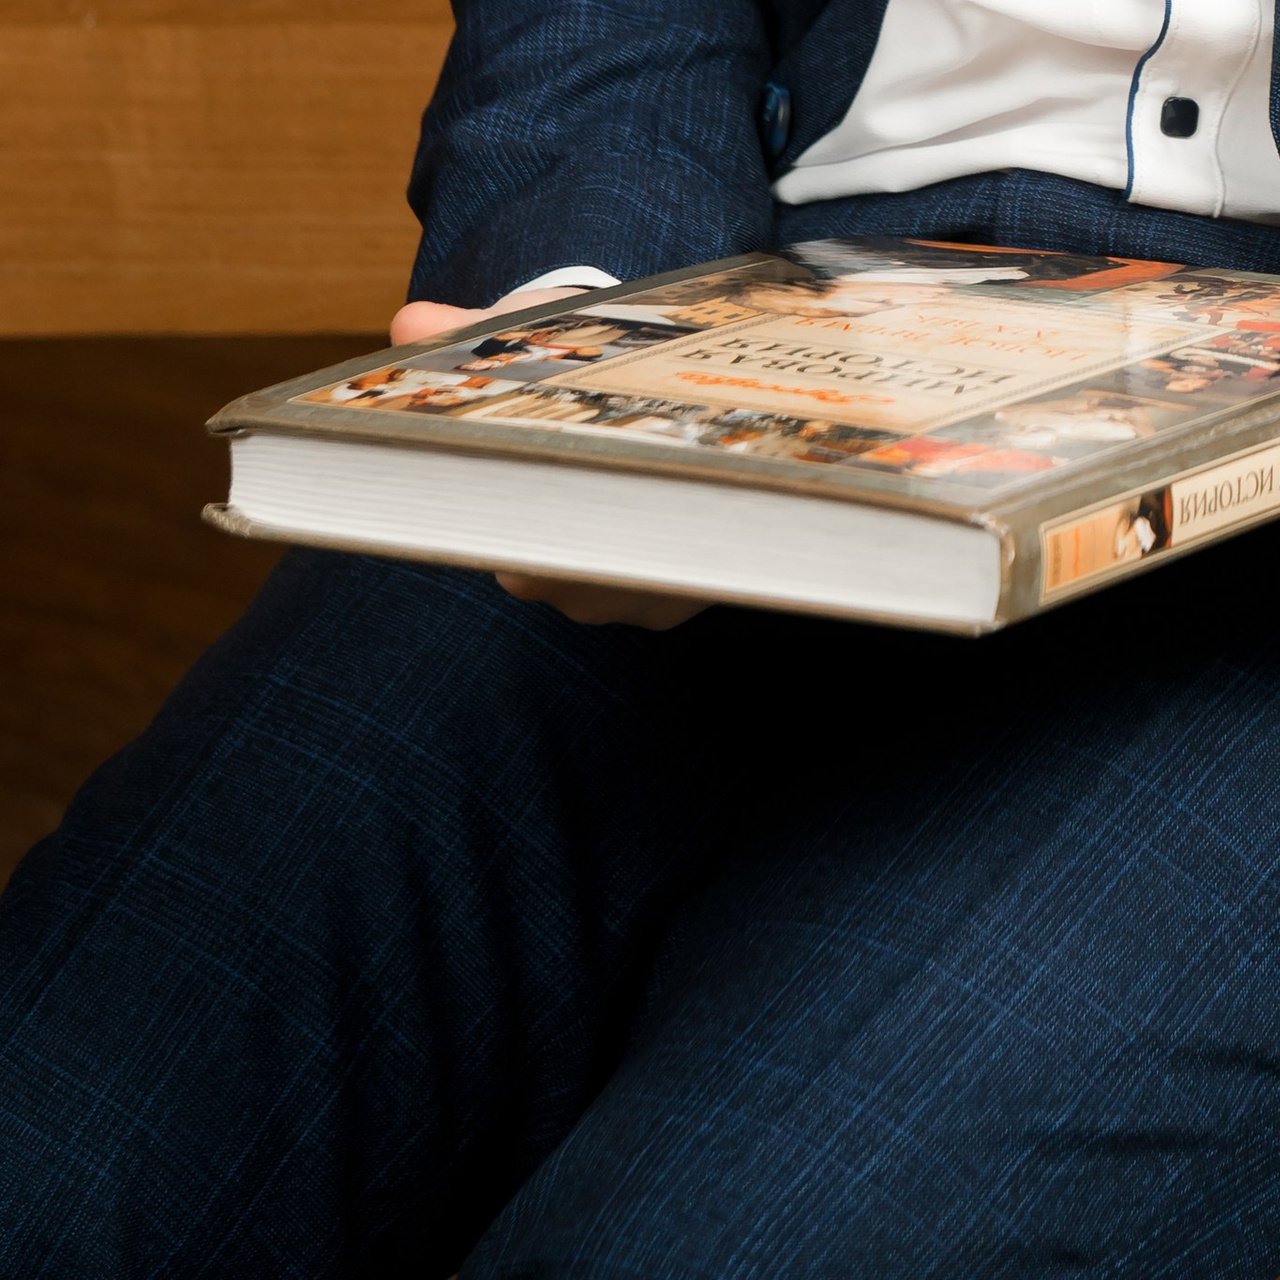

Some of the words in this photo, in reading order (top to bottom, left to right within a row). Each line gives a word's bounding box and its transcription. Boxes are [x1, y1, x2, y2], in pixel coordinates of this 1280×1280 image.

[682, 348, 986, 396] МИРОВАЯ
[718, 337, 1017, 384] ИСТОРИЯ
[1179, 468, 1274, 526] ИСТОРИЯ
